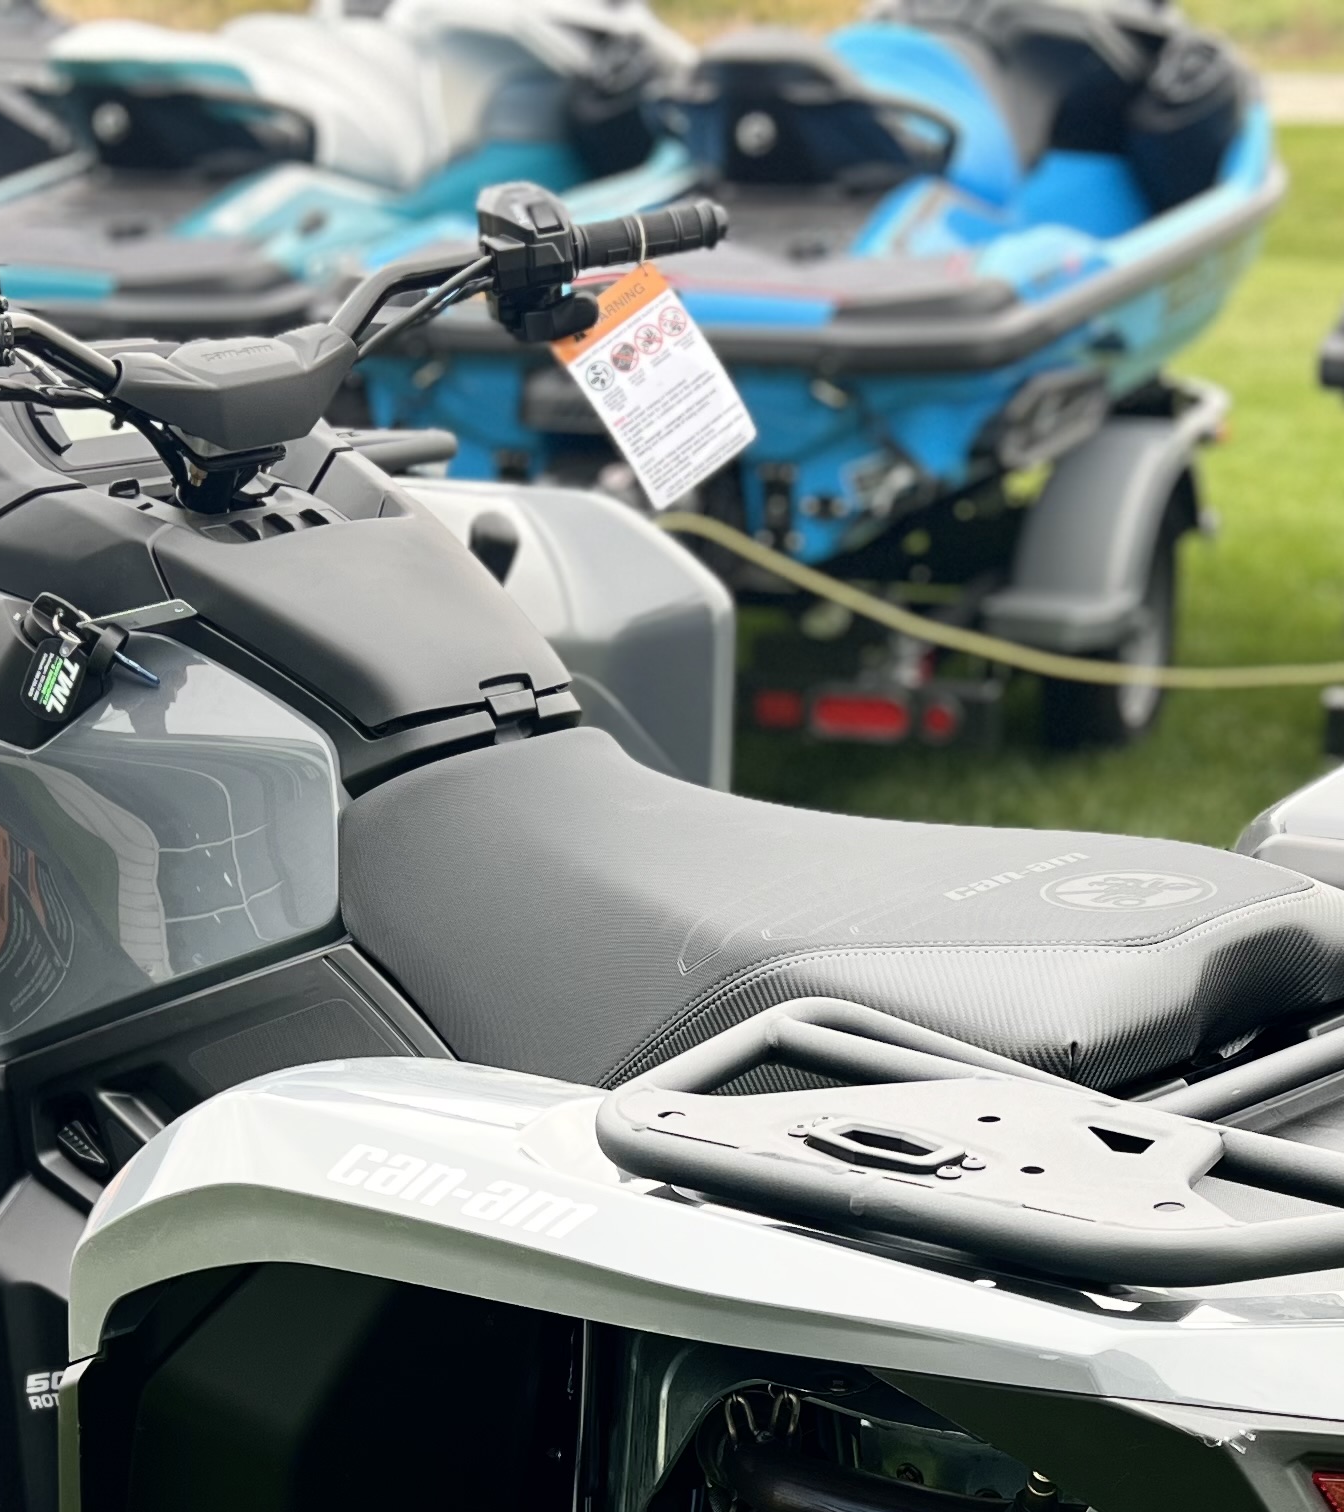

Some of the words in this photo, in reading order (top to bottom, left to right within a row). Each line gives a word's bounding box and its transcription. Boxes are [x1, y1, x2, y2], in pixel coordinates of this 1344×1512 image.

[596, 281, 646, 323] ARNING
[942, 851, 1089, 902] can-am
[326, 1143, 598, 1239] can-am
